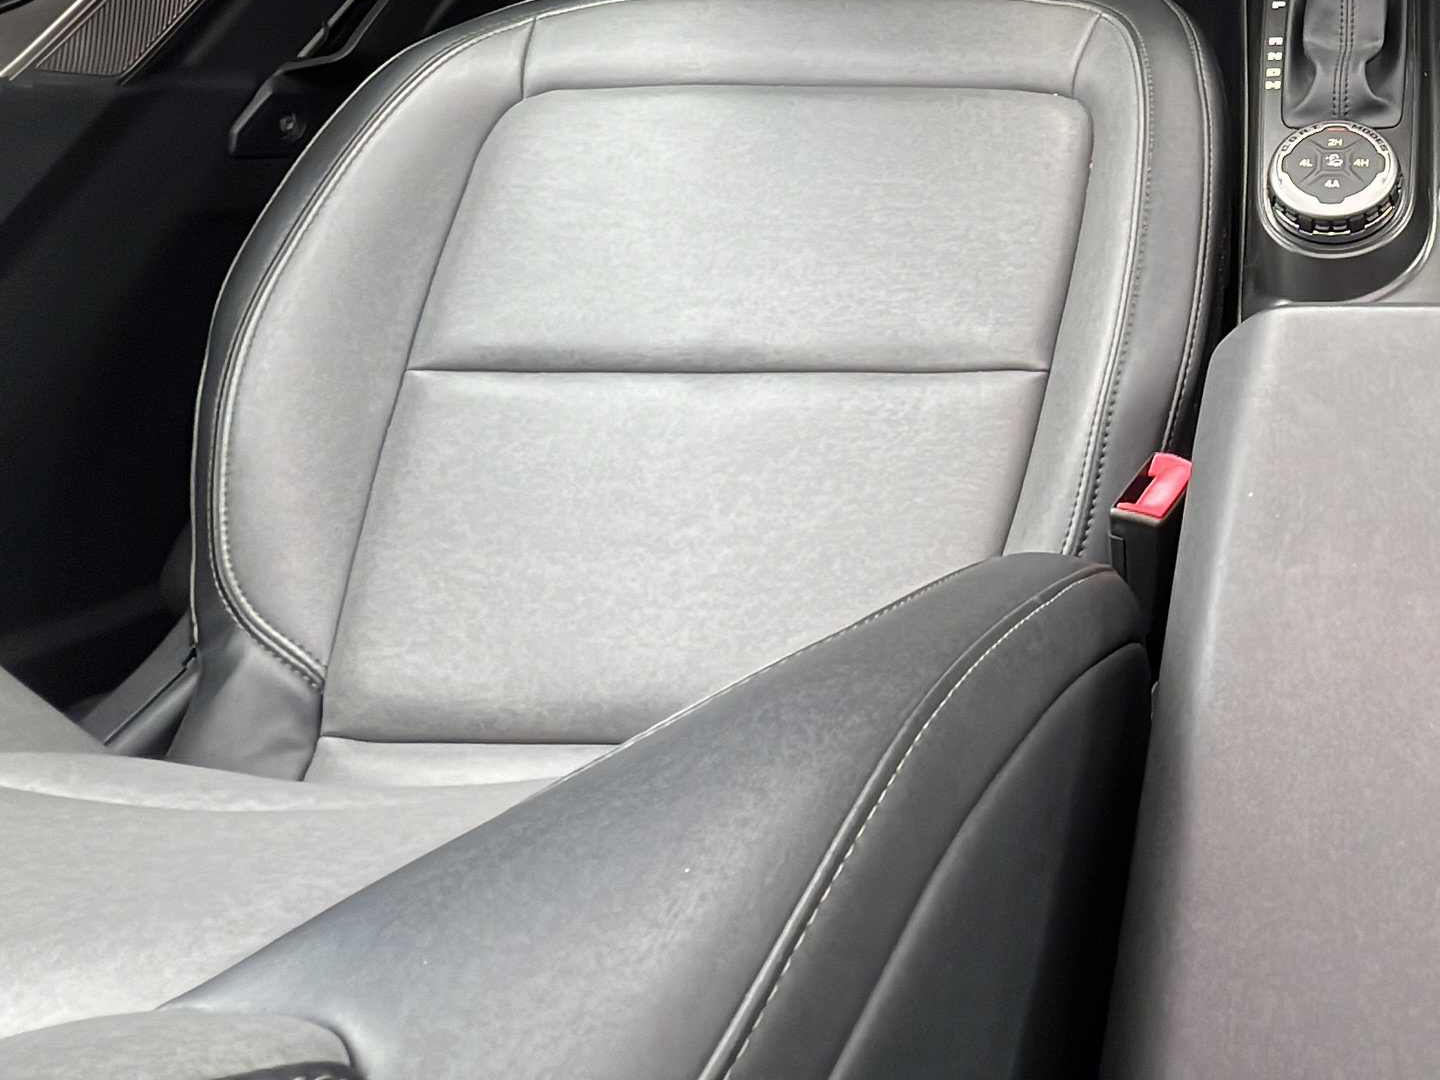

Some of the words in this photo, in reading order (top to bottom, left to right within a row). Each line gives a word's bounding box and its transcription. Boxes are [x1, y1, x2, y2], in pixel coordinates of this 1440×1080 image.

[1327, 138, 1343, 147] 2H
[1351, 123, 1389, 152] MODES
[1299, 158, 1313, 168] 4L
[1353, 158, 1370, 168] 4H
[1324, 179, 1340, 188] 4A
